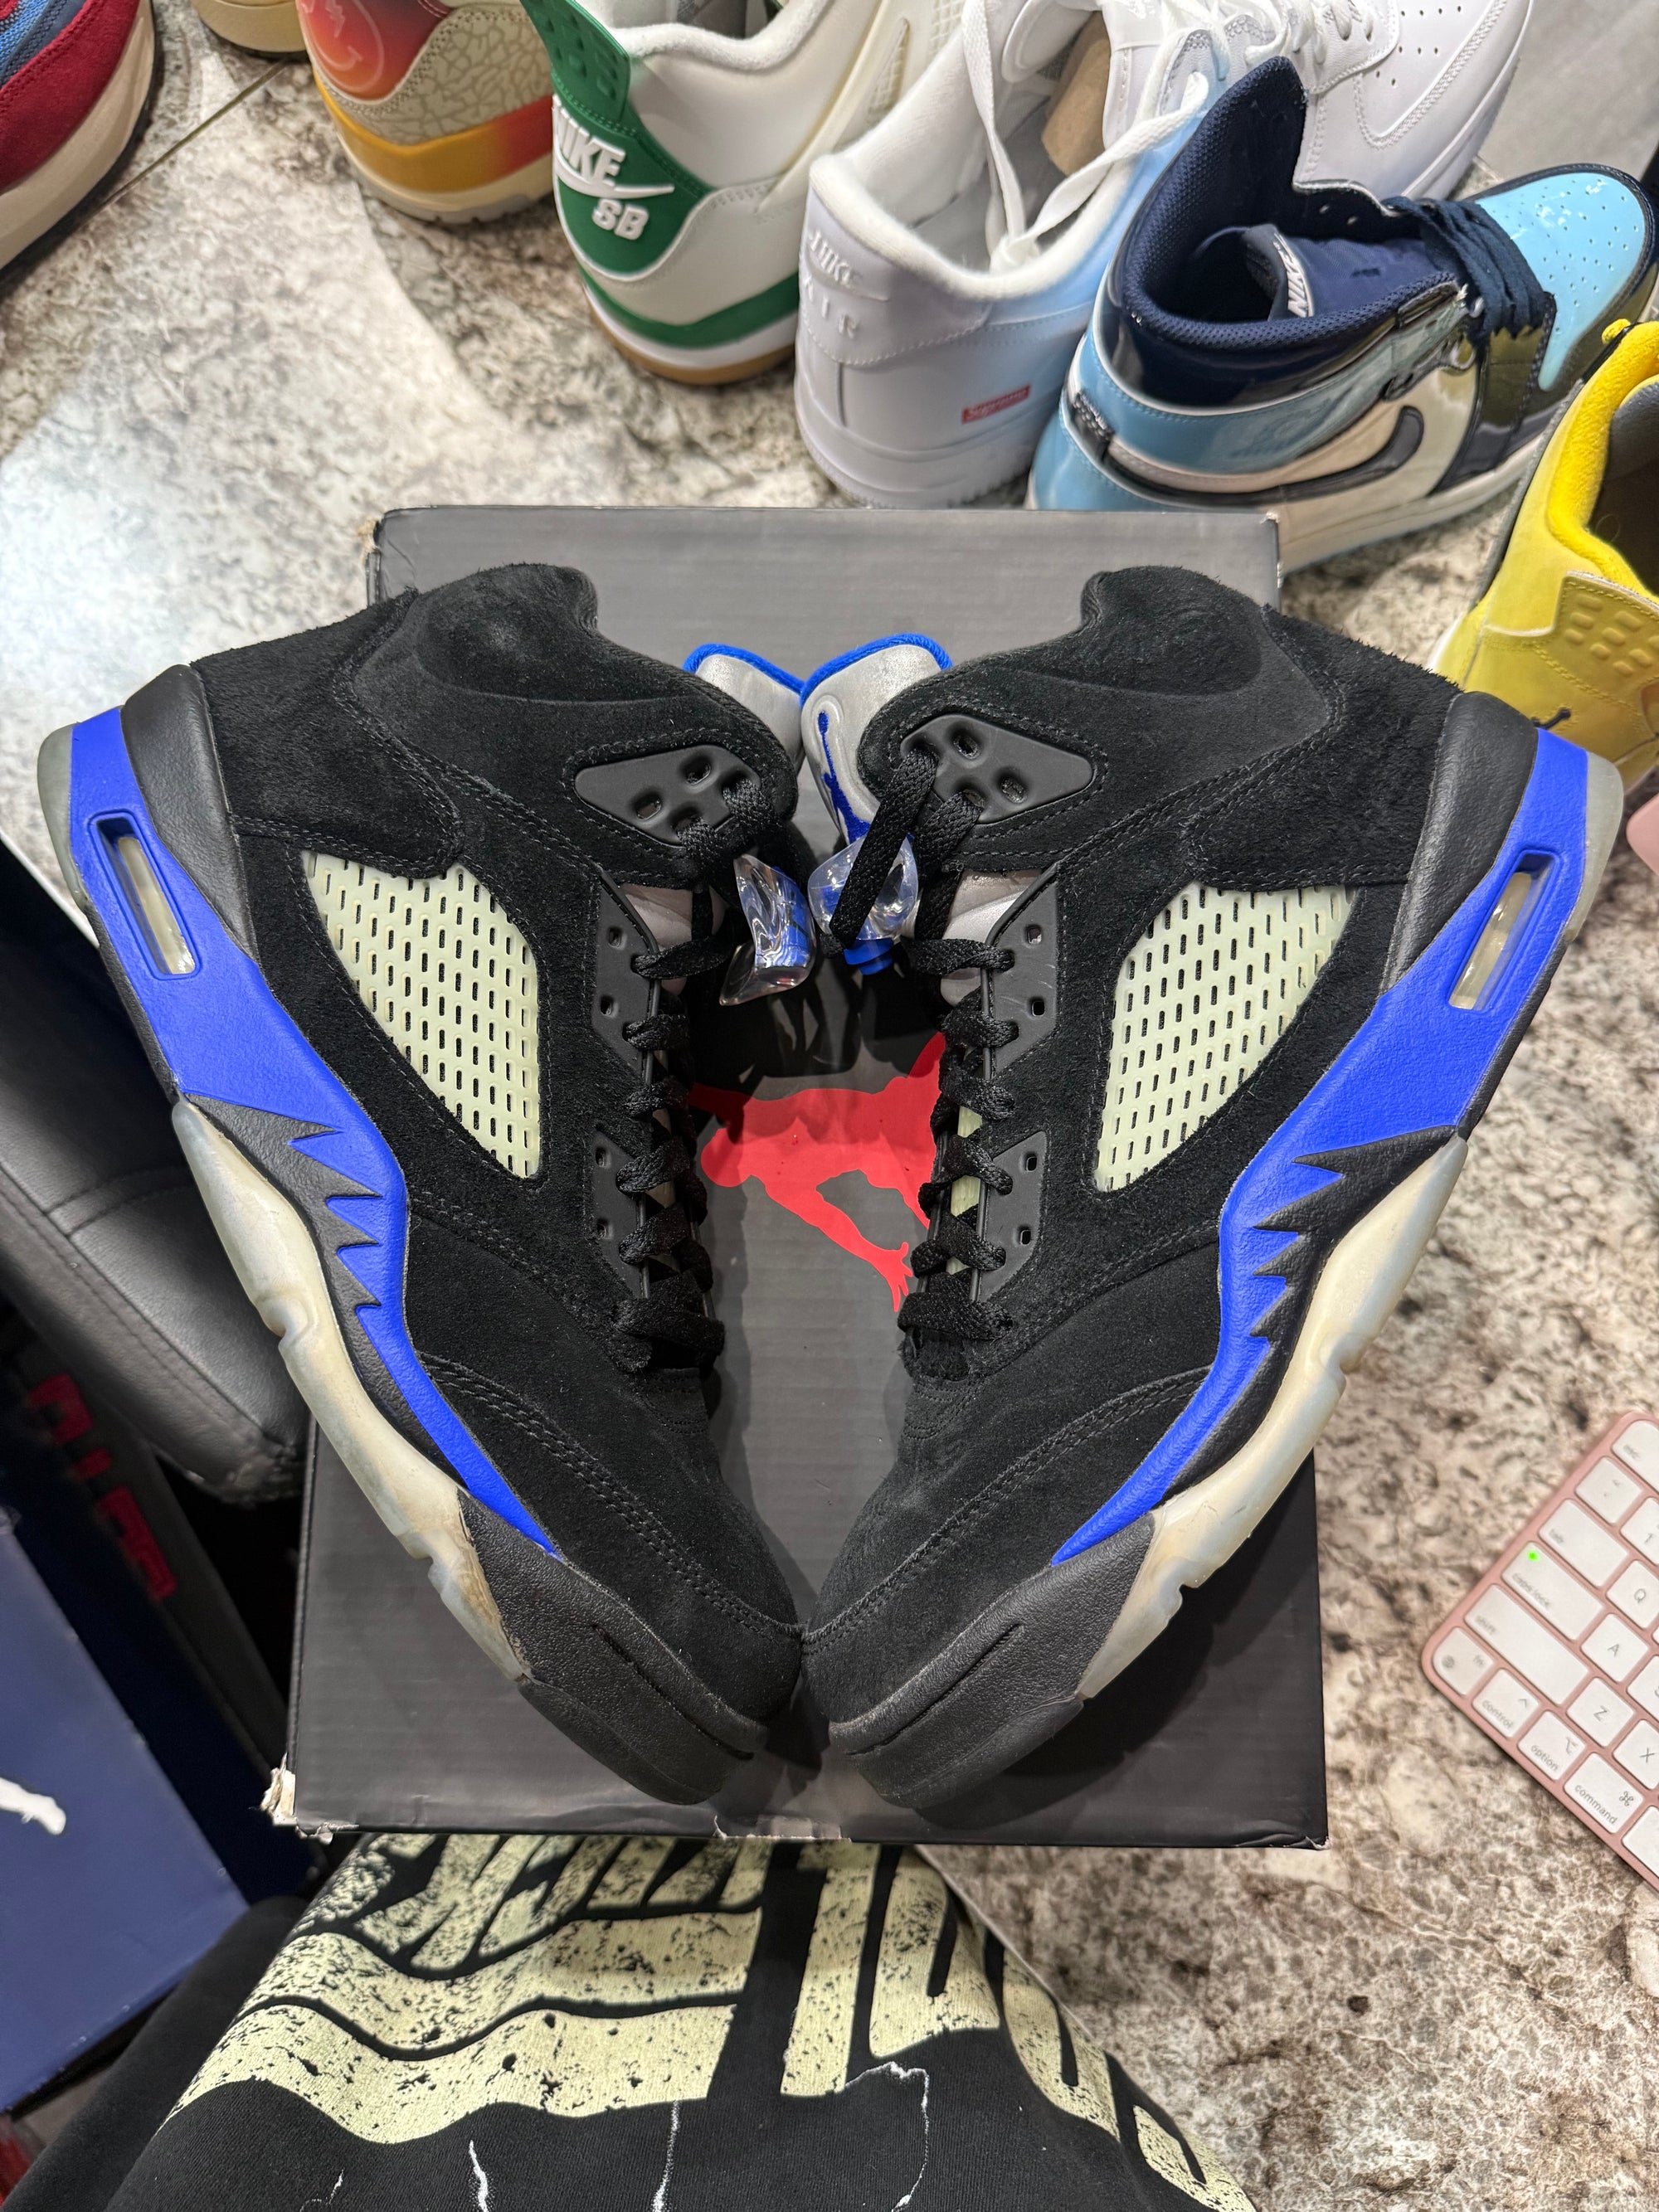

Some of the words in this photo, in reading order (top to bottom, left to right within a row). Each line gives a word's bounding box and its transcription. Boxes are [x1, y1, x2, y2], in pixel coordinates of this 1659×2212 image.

[552, 93, 626, 187] NIKE
[591, 198, 649, 241] SB
[1277, 248, 1307, 318] NIKE
[1633, 1588, 1647, 1604] Q
[1607, 1643, 1620, 1657] A
[1481, 1699, 1514, 1730] control
[1593, 1705, 1609, 1722] Z
[1530, 1744, 1559, 1772] option
[1639, 1748, 1656, 1764] X
[1574, 1784, 1618, 1826] command
